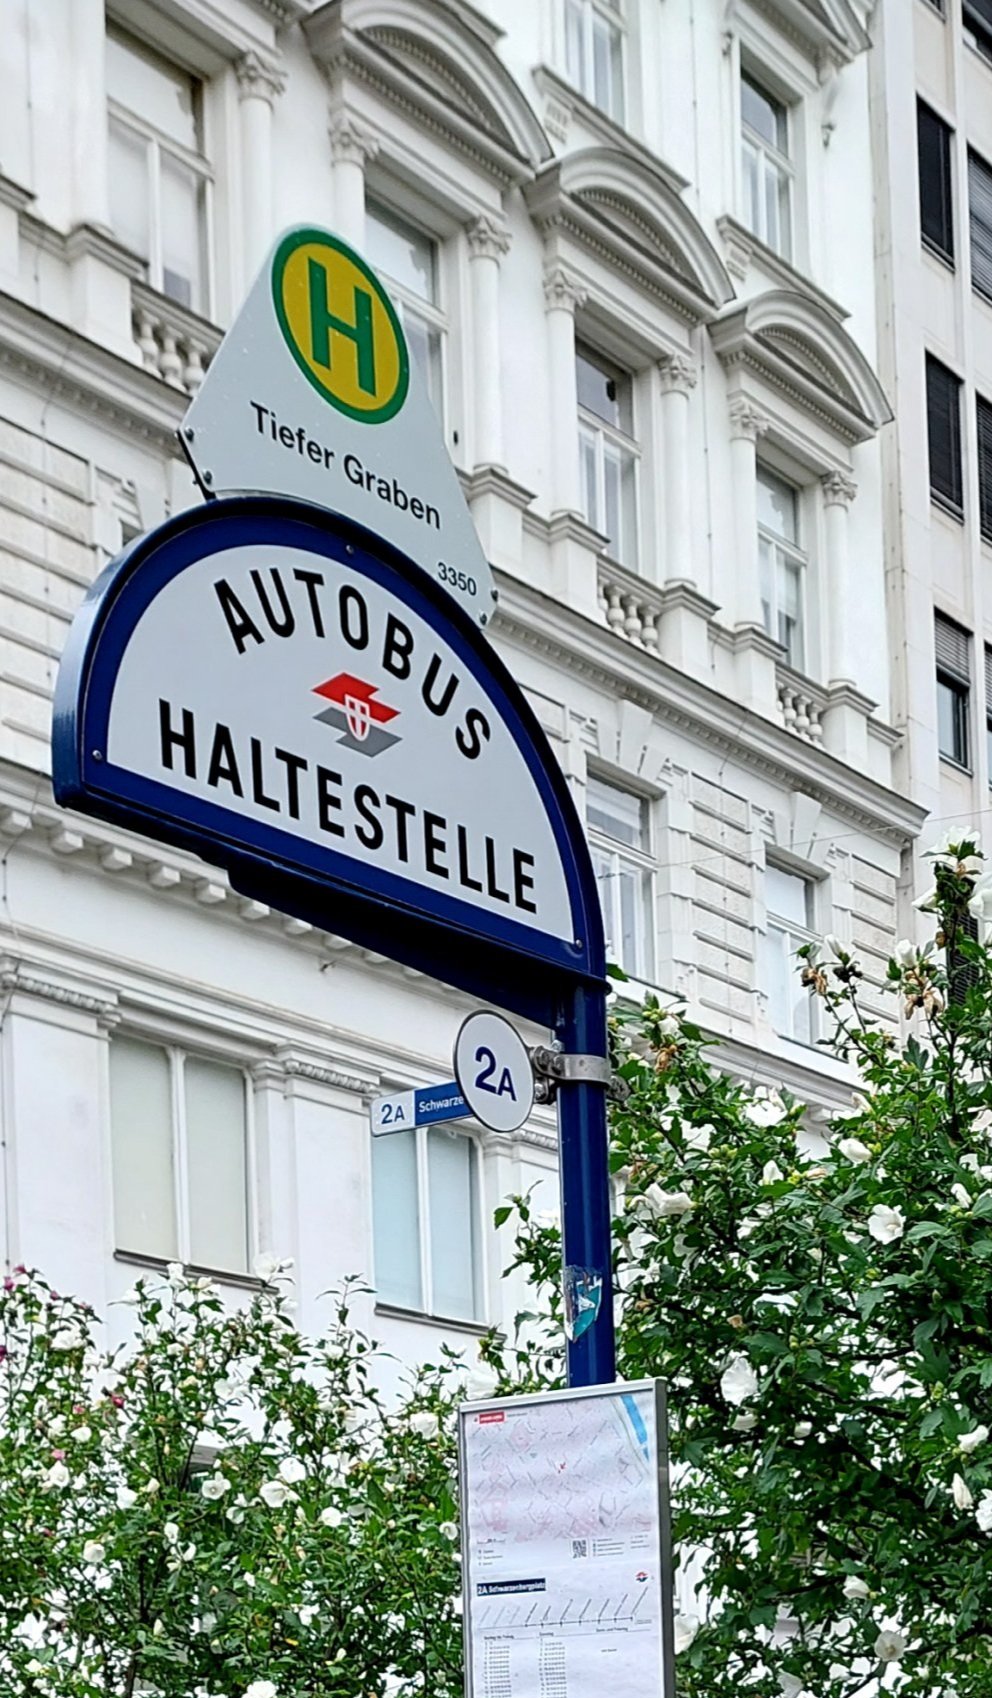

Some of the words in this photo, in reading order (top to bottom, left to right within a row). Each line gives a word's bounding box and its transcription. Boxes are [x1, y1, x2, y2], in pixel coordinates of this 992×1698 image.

[307, 256, 376, 398] H
[250, 400, 334, 470] Tiefer
[342, 453, 440, 530] Graben
[437, 562, 477, 597] 3350
[213, 567, 491, 760] AUTOBUS
[159, 697, 537, 914] HALTESTELLE
[381, 1103, 405, 1125] 2A
[475, 1046, 517, 1102] 2A
